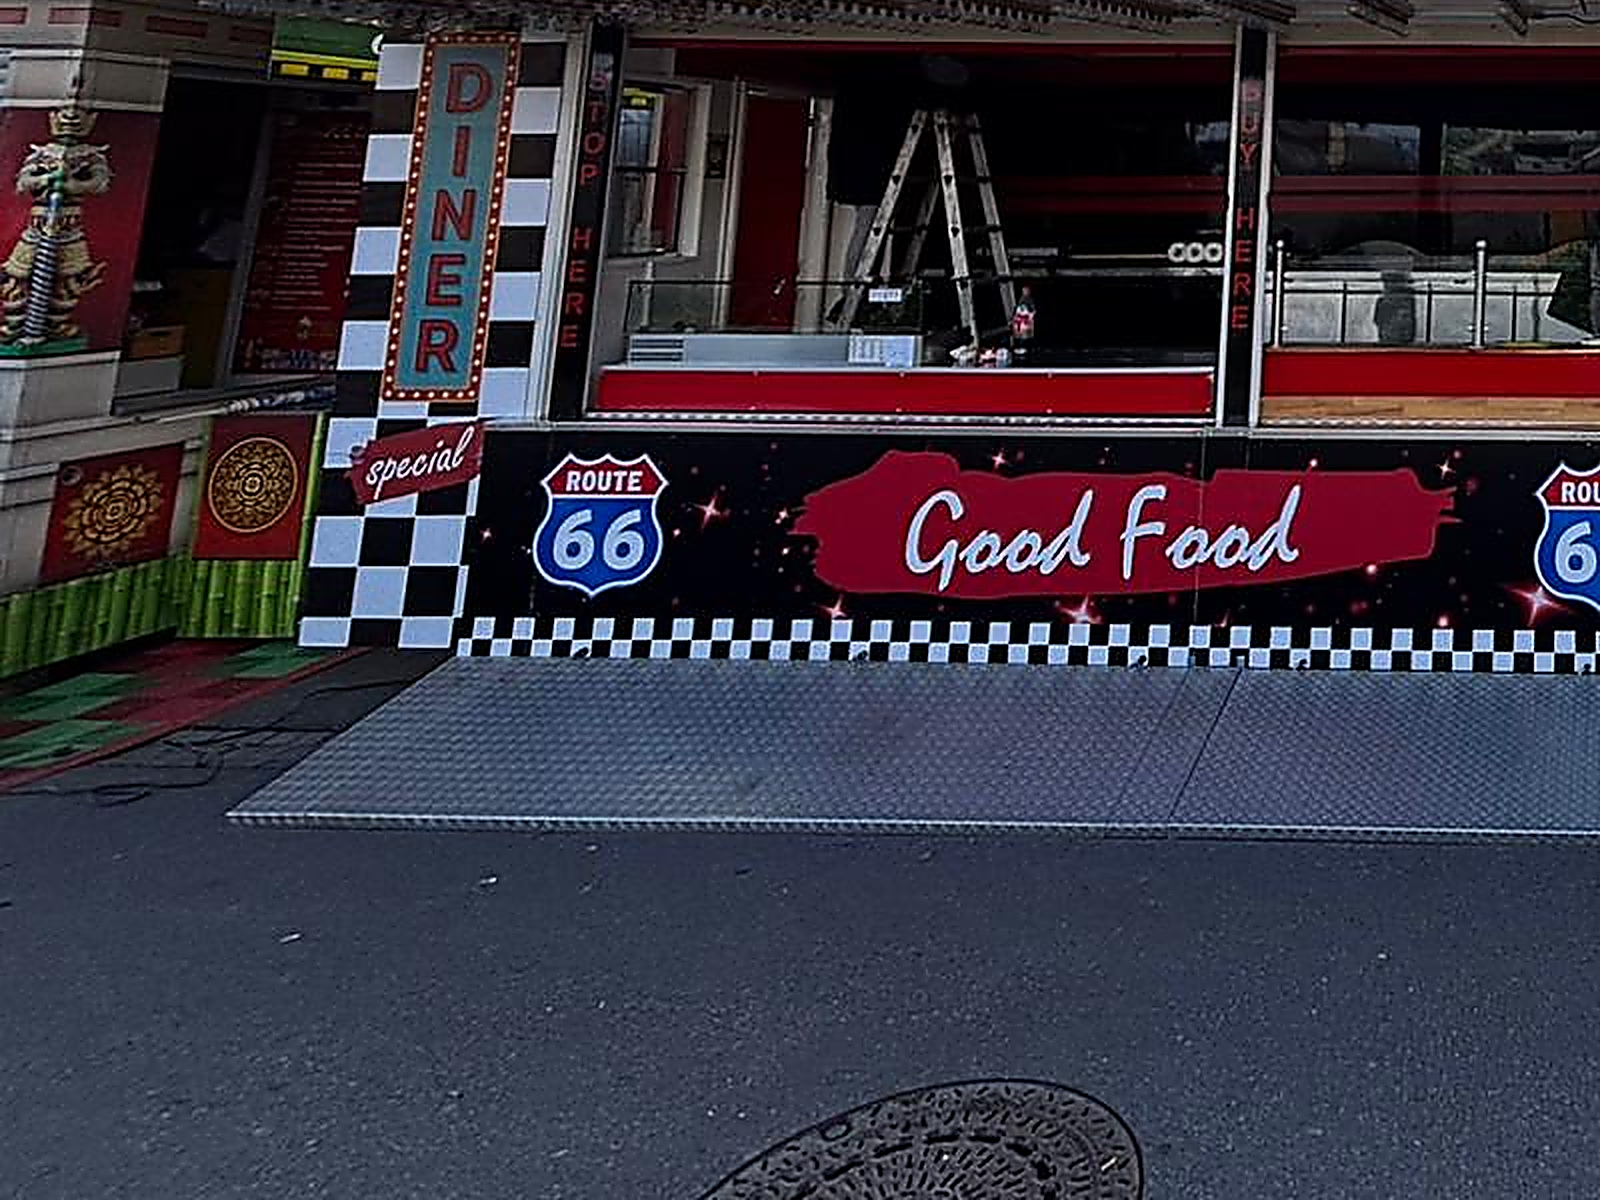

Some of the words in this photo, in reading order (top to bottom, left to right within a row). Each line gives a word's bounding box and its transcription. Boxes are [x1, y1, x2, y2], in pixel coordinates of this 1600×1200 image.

[578, 69, 609, 187] STOP
[413, 60, 495, 376] DINER
[1231, 206, 1255, 330] HERE
[560, 226, 594, 350] HERE
[365, 425, 475, 500] special
[565, 470, 643, 492] ROUTE
[553, 508, 645, 571] 66
[904, 488, 1094, 592] Good
[1119, 483, 1301, 581] Food
